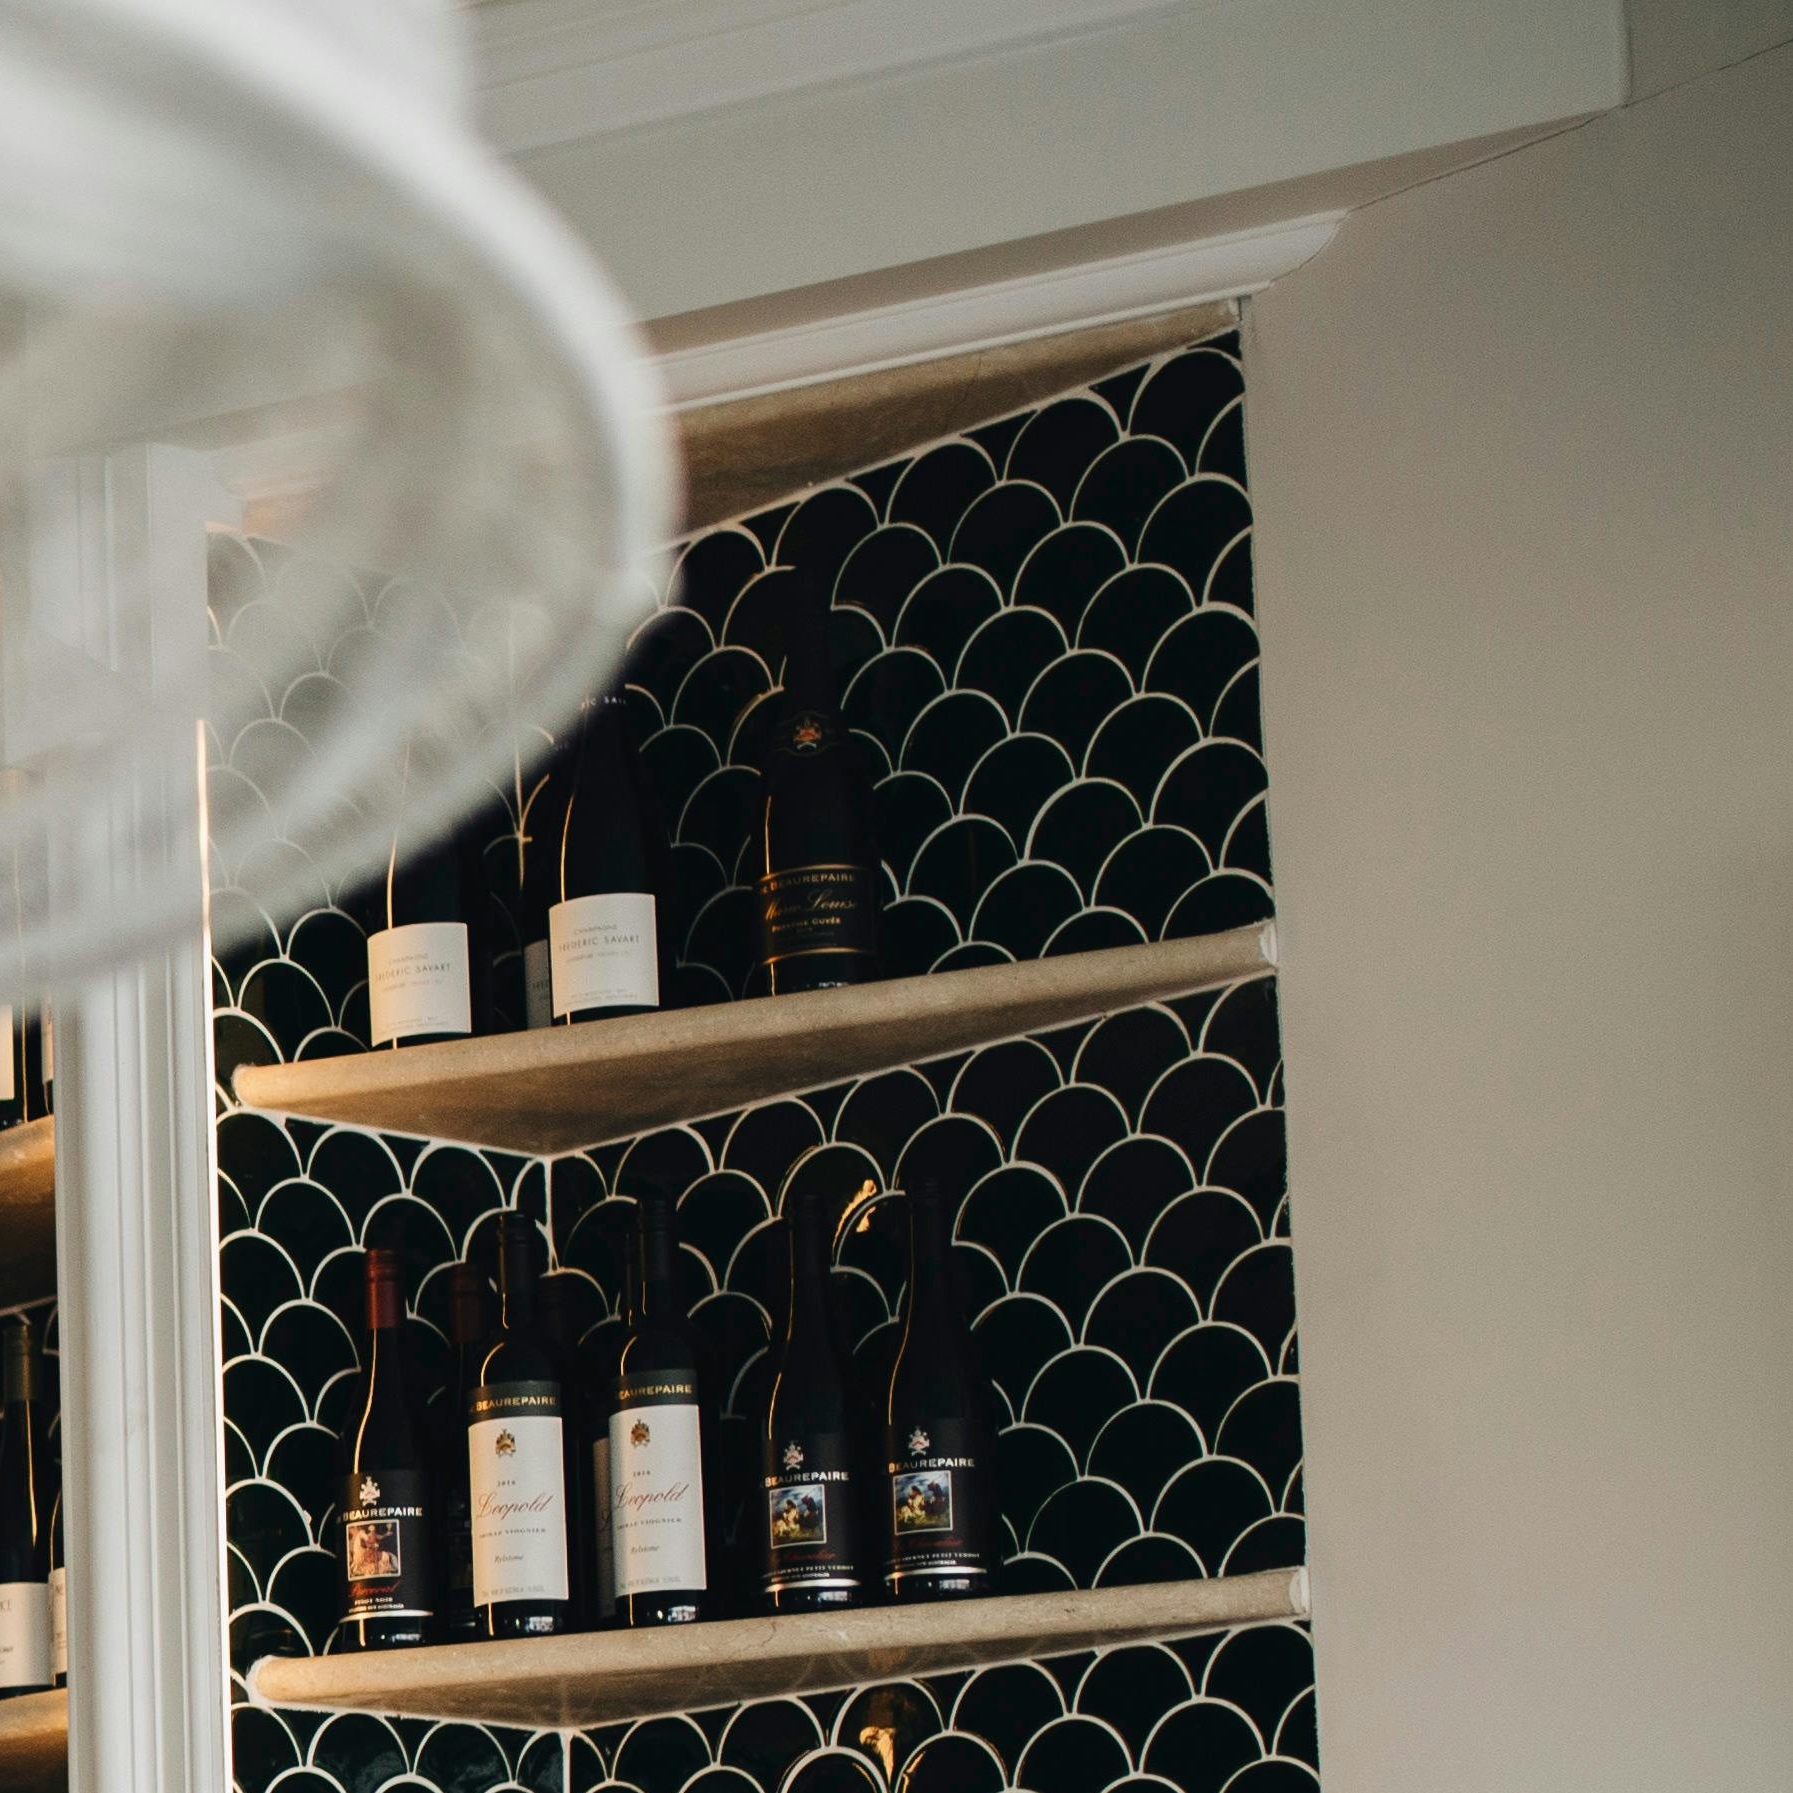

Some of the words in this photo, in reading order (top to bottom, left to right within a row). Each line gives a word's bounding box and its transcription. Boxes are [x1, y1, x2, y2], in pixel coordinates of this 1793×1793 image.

[475, 1396, 556, 1412] BEAUREPAIRE
[888, 1457, 975, 1474] BEAUREPAIRE
[764, 1471, 850, 1488] BEAUREPAIRE
[615, 1482, 690, 1511] Leopold
[343, 1506, 423, 1522] BEAUREPAIRE
[476, 1491, 554, 1520] Leopold
